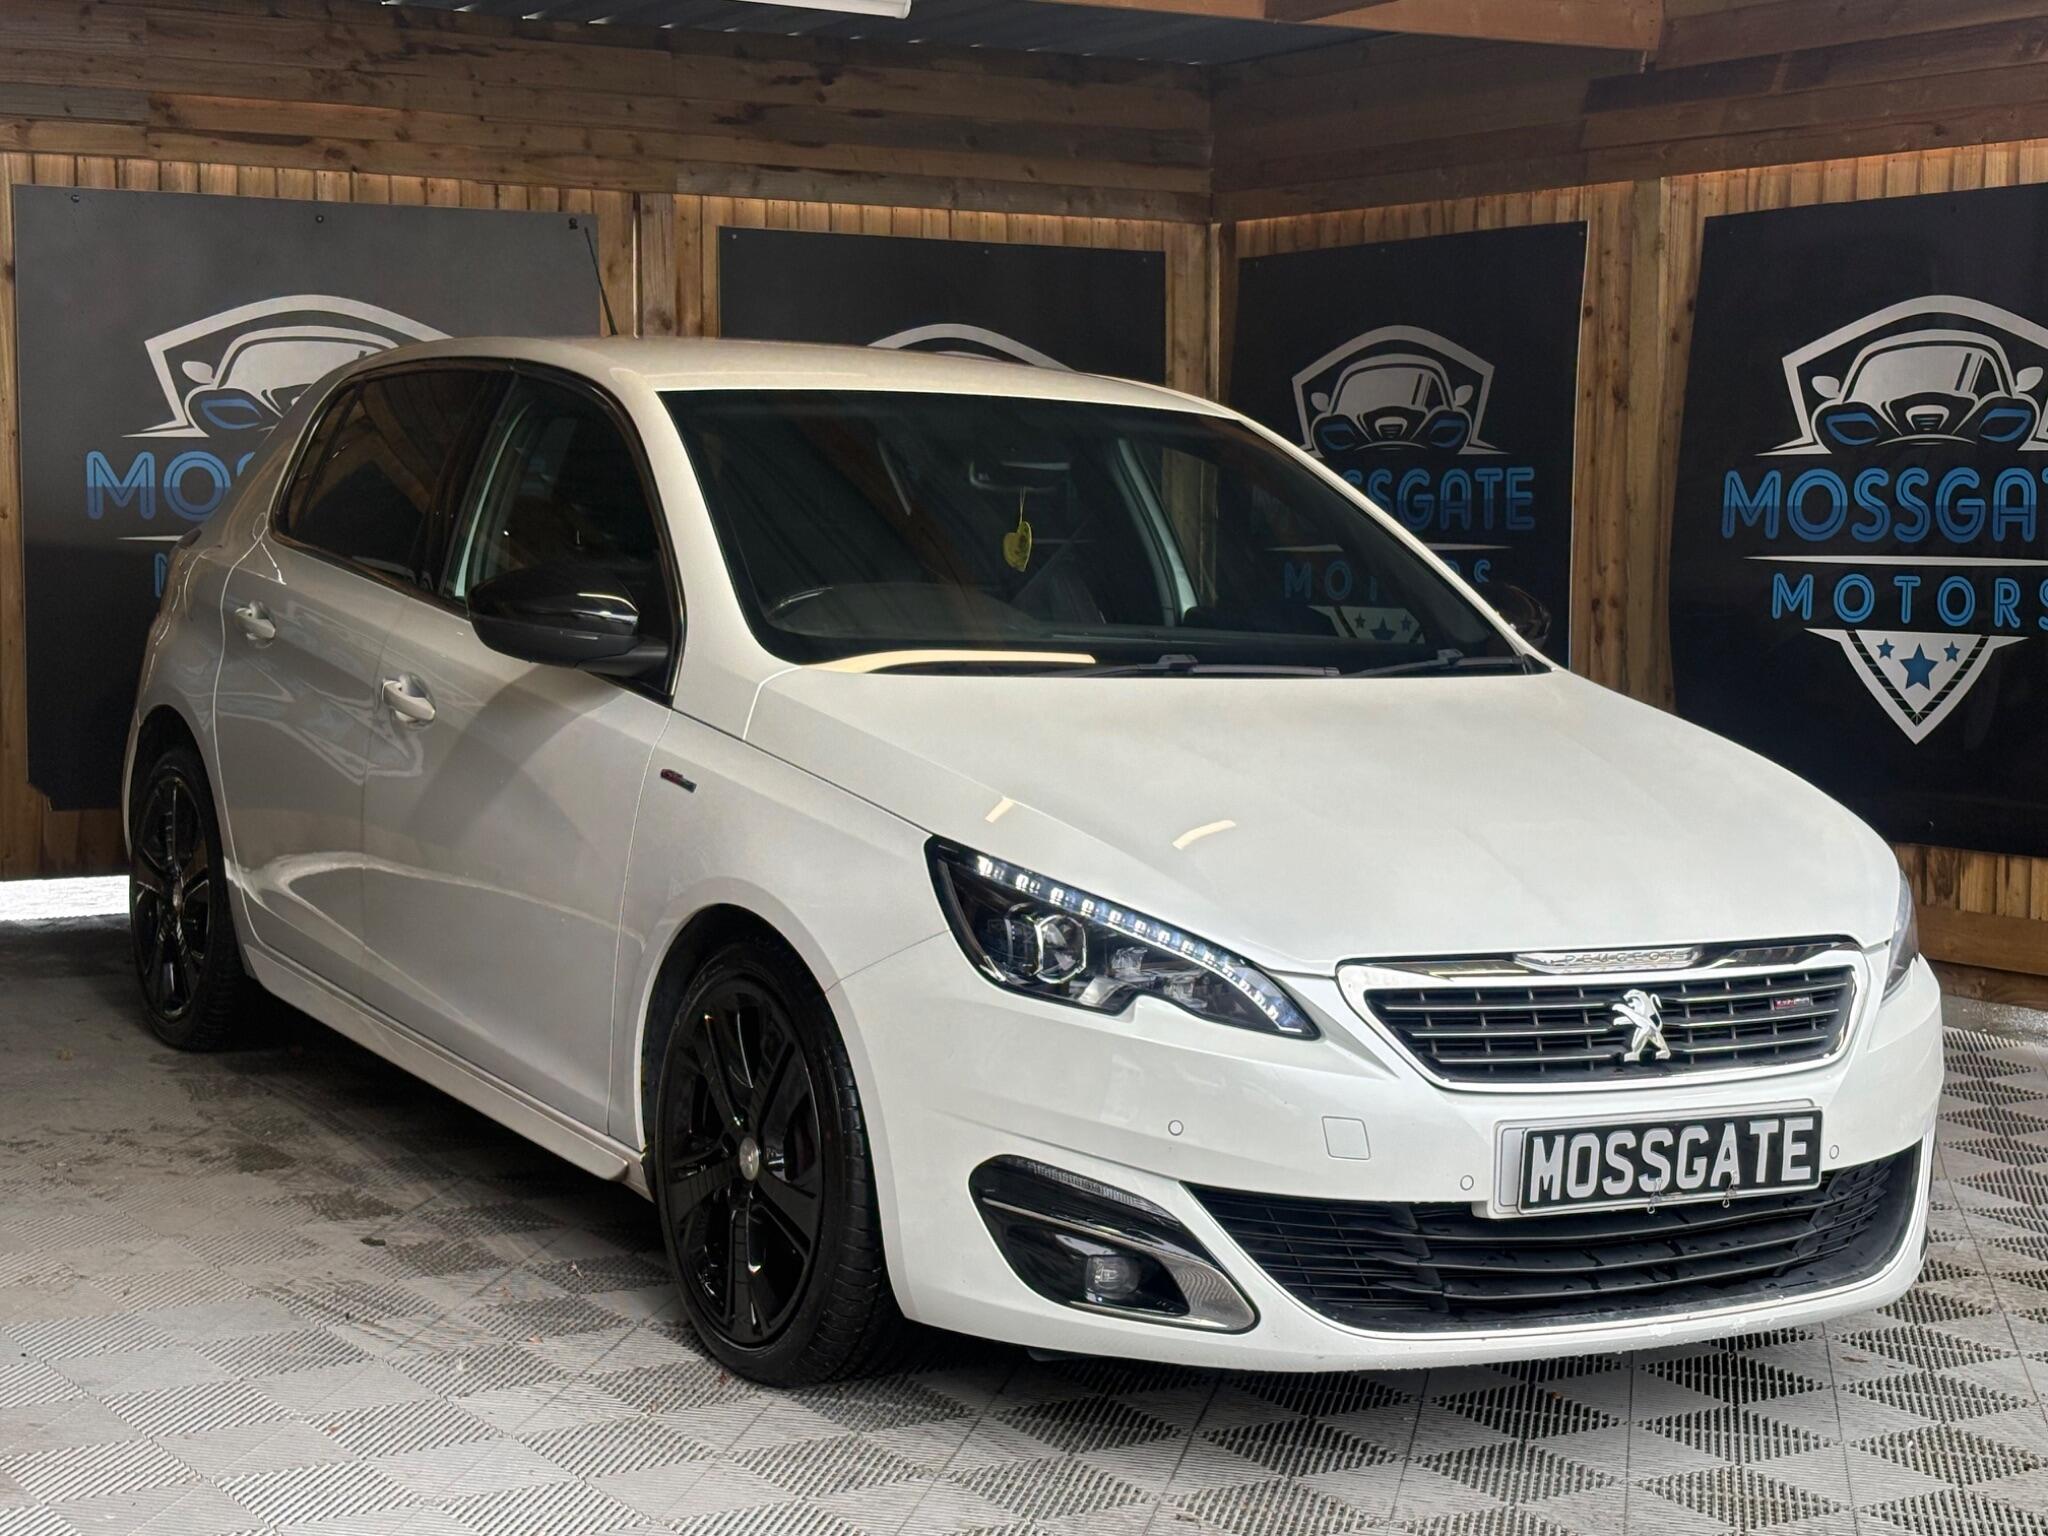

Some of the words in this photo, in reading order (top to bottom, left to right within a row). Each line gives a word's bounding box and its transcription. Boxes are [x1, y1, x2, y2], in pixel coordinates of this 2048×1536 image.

[1721, 466, 2048, 544] MOSSGA
[1564, 950, 1674, 965] PEUGEOT
[1529, 1115, 1814, 1204] MOSSGATE
